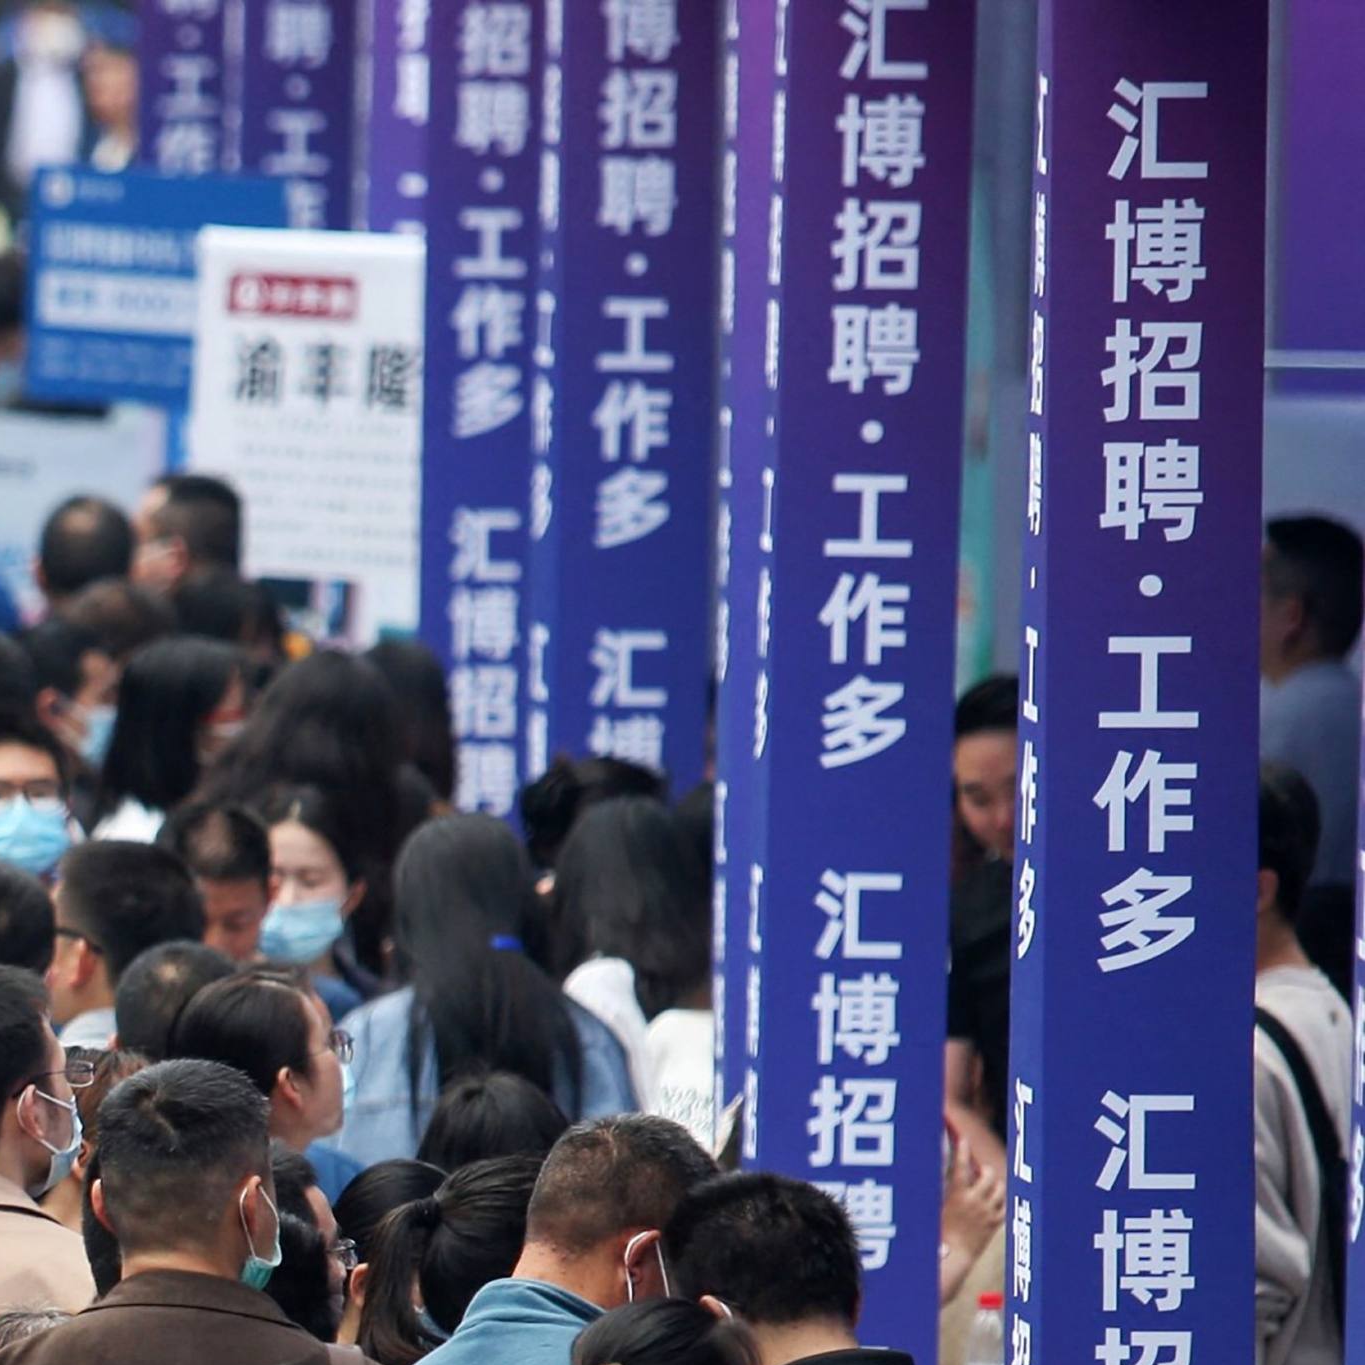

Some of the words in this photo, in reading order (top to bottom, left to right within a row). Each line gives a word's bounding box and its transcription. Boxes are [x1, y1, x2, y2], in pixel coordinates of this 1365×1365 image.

[819, 0, 929, 768] 汇博招聘·工作多
[1017, 71, 1049, 960] 汇博招聘·工作多
[1092, 76, 1209, 973] 汇博招聘·工作多
